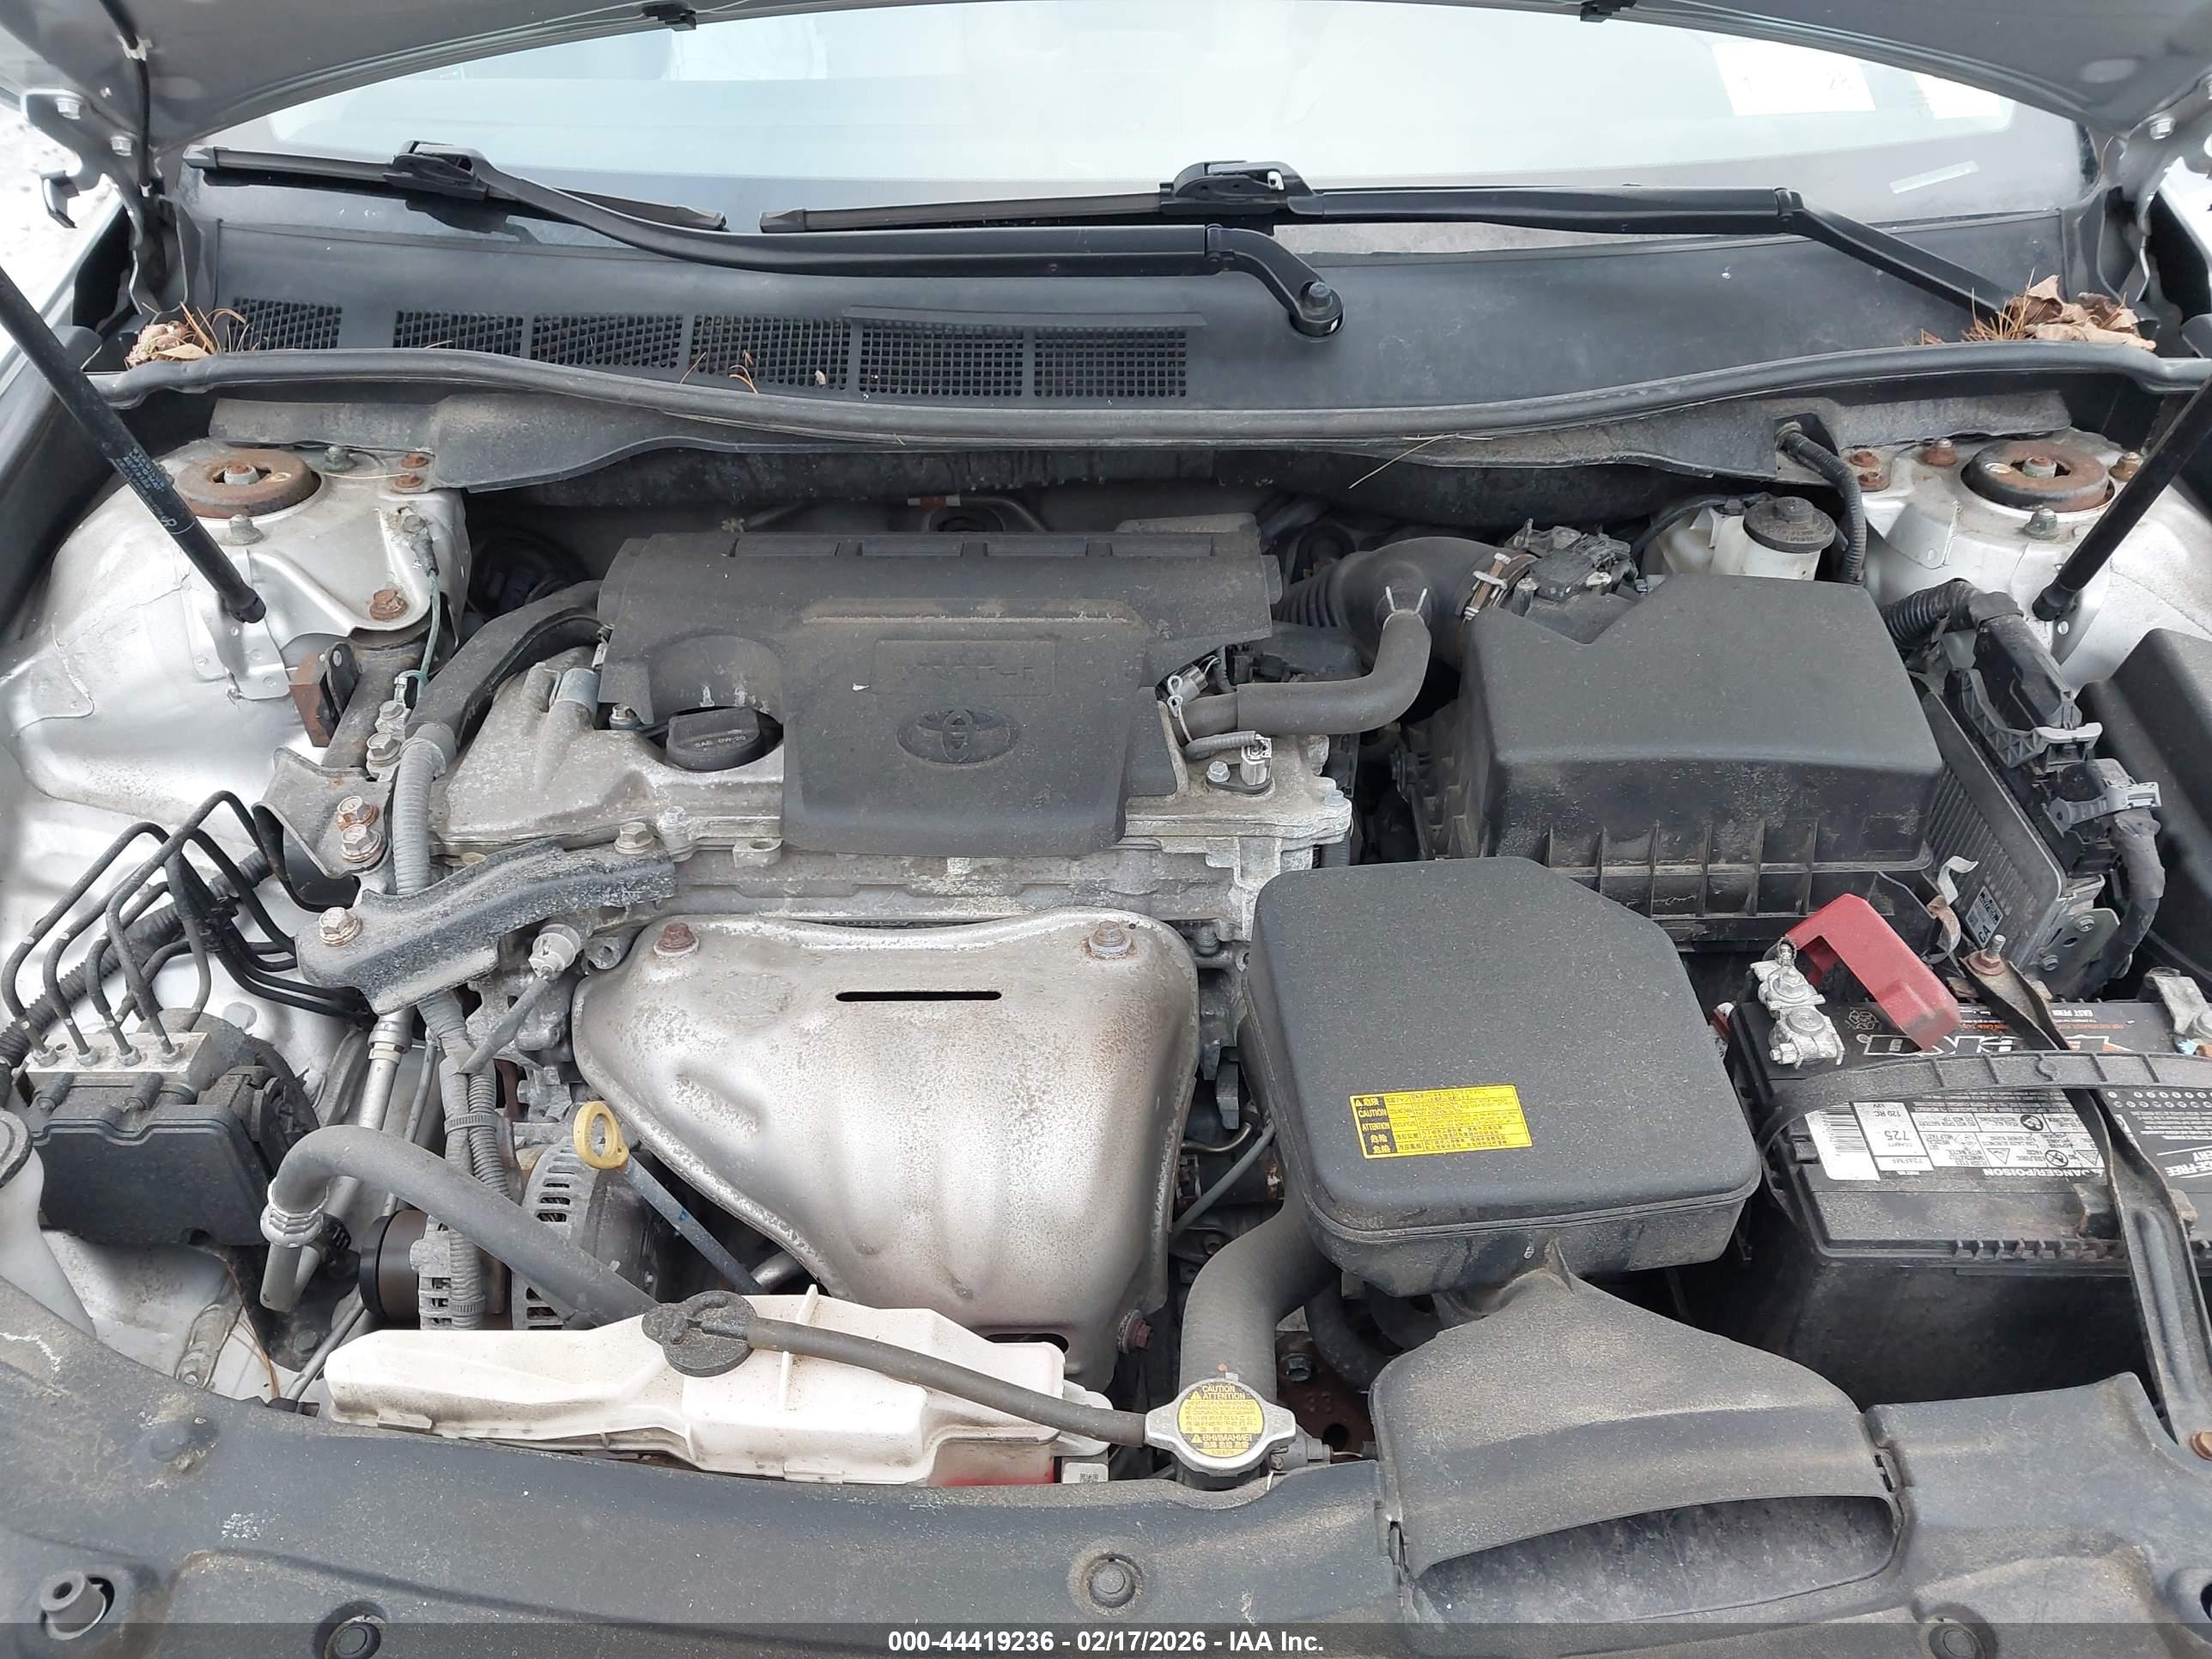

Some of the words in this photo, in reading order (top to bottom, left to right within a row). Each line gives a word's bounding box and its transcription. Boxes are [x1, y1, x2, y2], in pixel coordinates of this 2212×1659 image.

[1358, 1108, 1388, 1118] CAUTION
[1361, 1121, 1391, 1132] ATTENTION
[1884, 1129, 1911, 1141] 725
